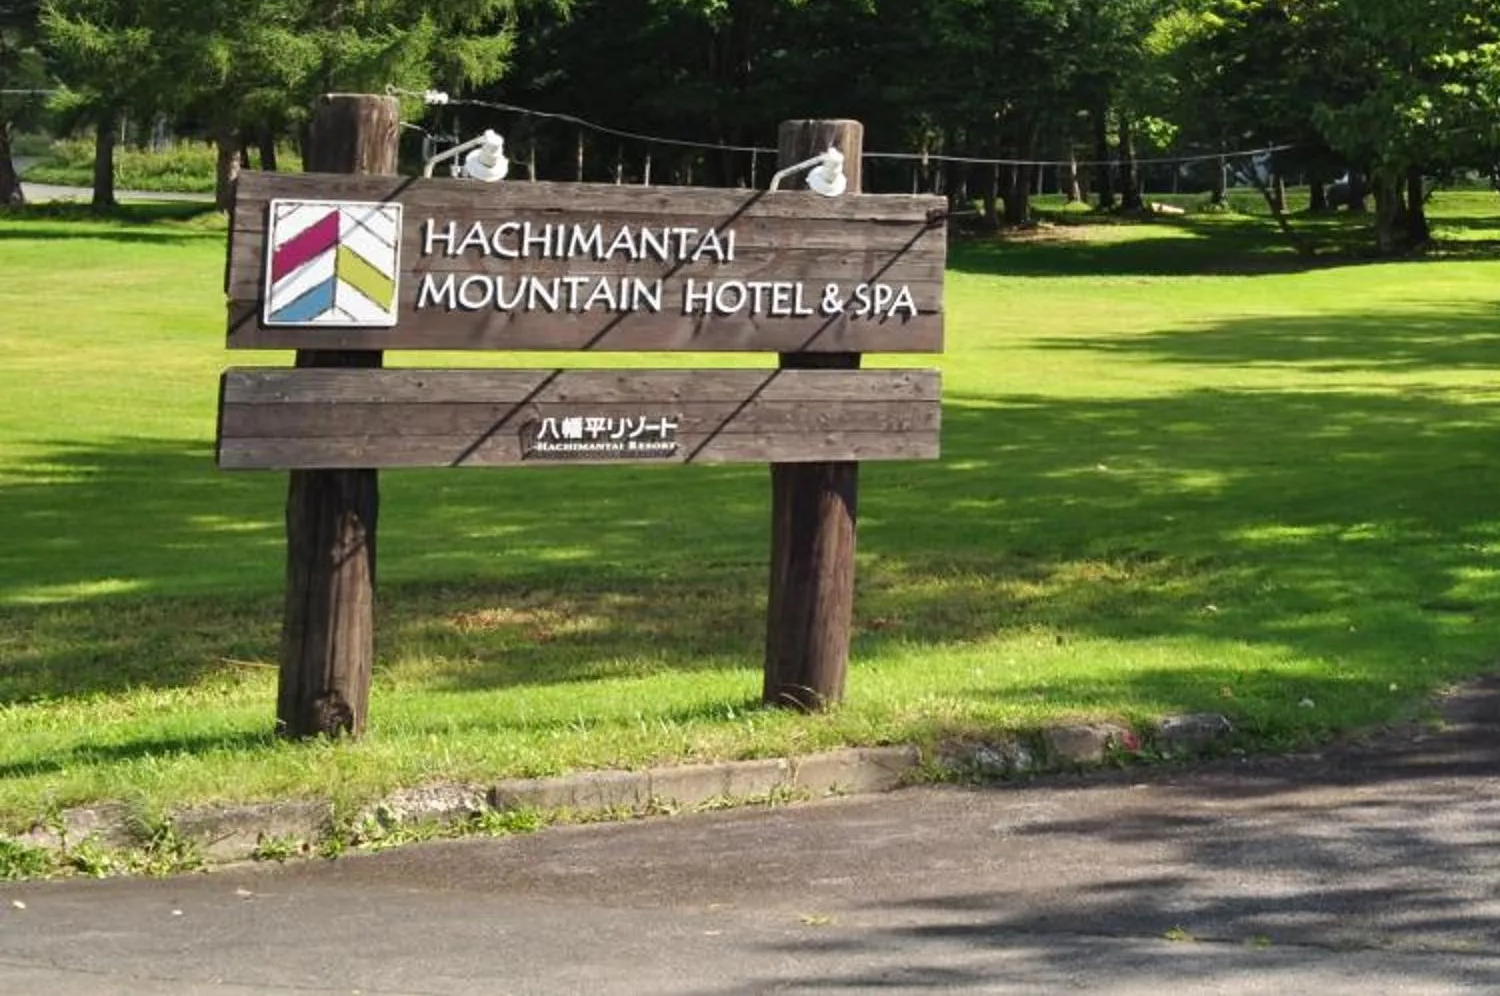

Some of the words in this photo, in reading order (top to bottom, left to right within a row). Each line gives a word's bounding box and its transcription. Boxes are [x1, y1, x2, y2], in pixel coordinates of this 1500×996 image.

[425, 217, 736, 262] HACHIMANTAI
[418, 273, 662, 312] MOUNTAIN
[685, 278, 814, 316] HOTEL
[822, 282, 845, 314] &
[855, 283, 918, 318] SPA
